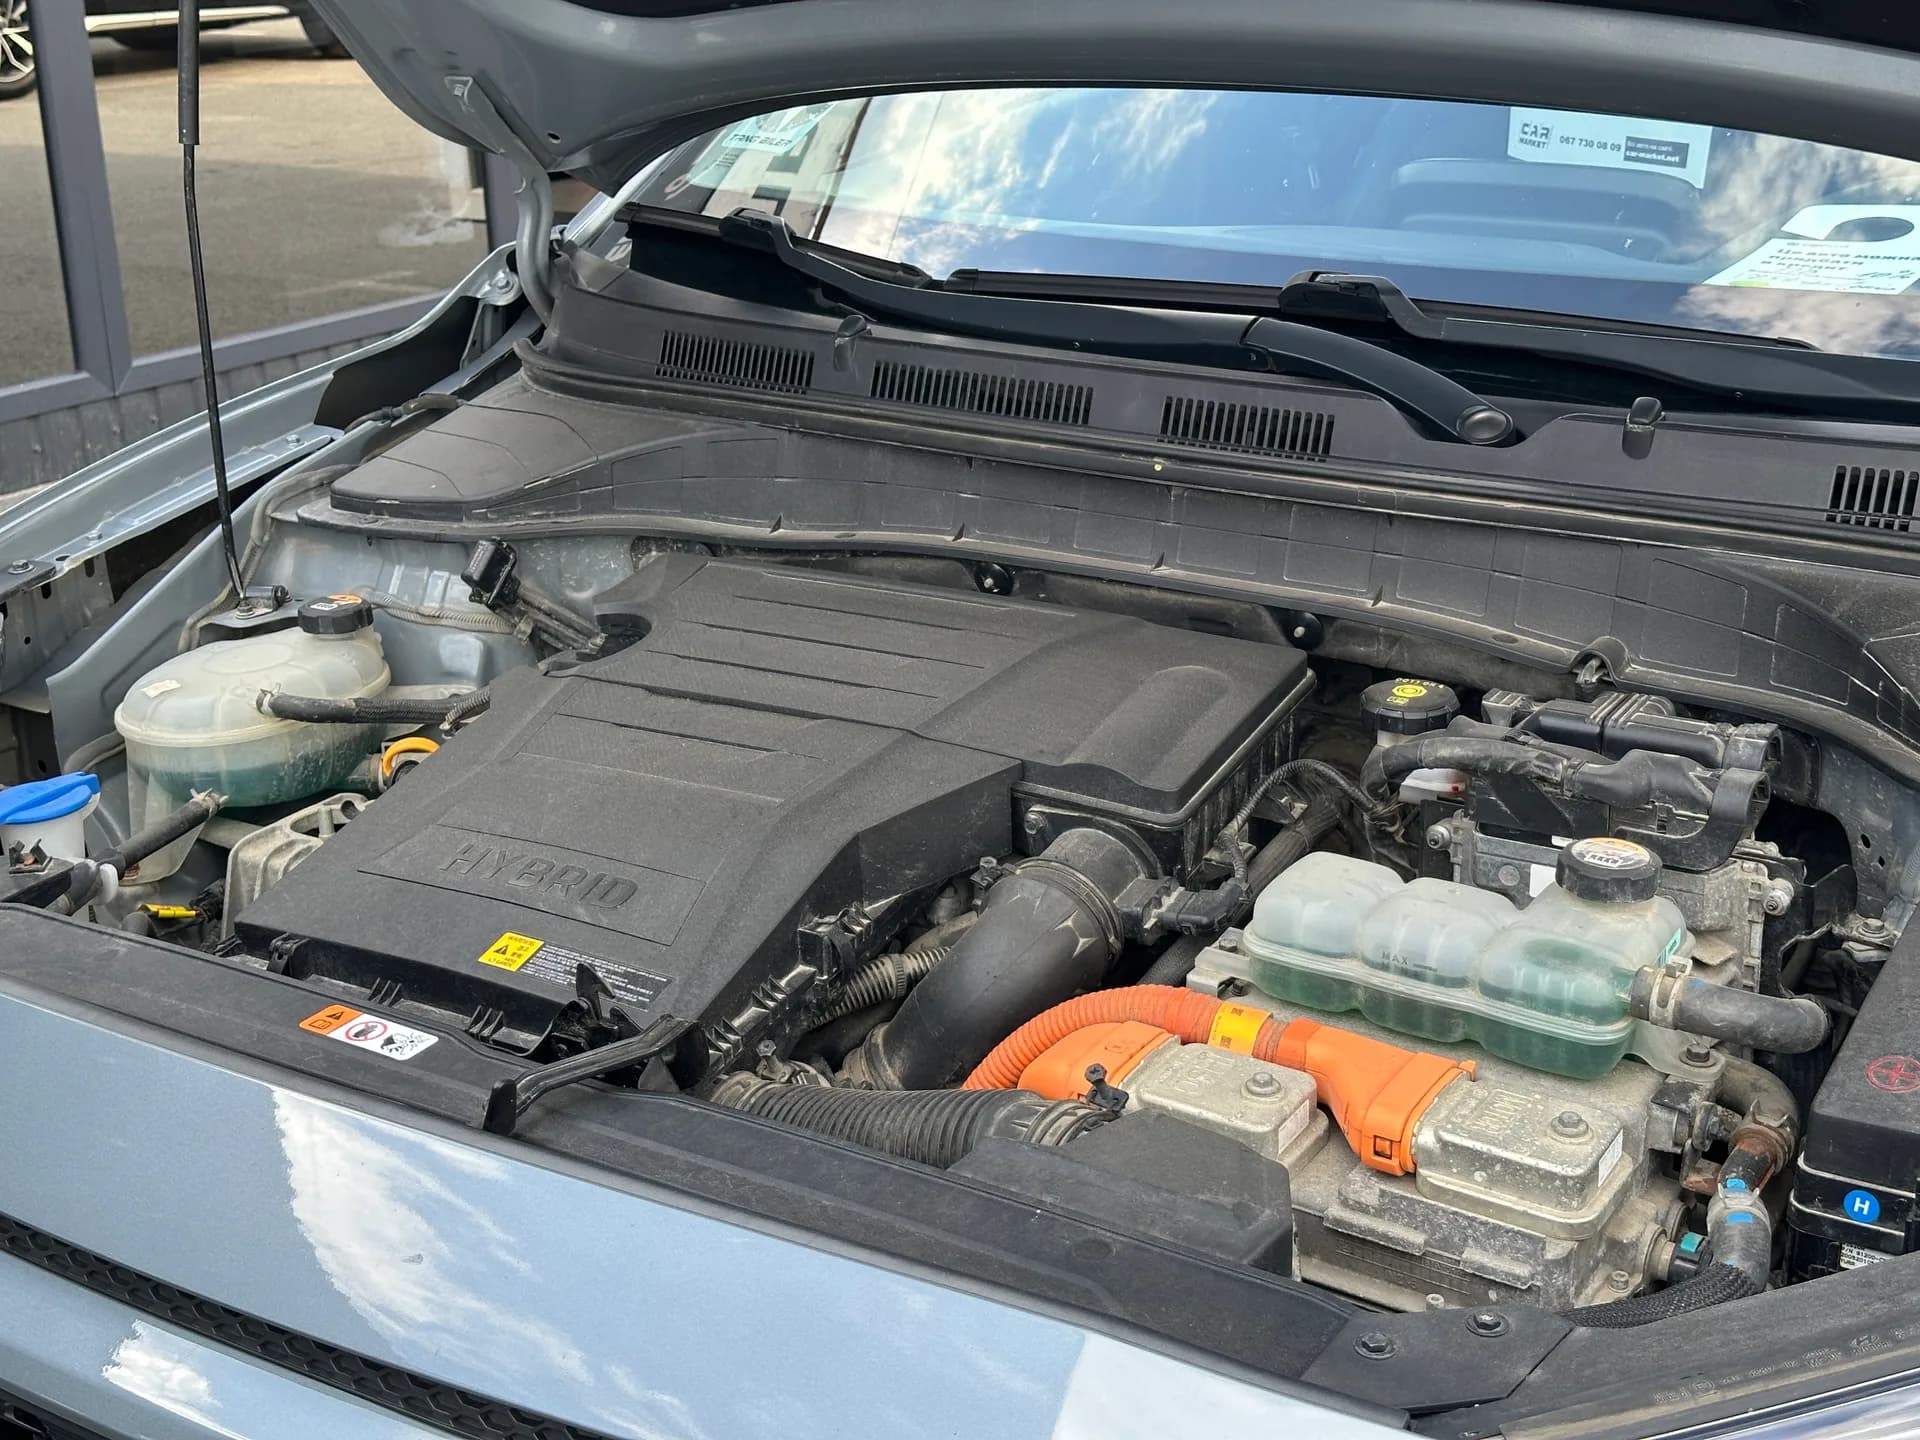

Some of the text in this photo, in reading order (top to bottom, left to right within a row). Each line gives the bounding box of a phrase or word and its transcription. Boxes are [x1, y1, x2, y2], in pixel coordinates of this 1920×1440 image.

[1521, 123, 1550, 140] CAR
[1578, 138, 1594, 148] 730
[1610, 143, 1622, 152] 09
[440, 843, 639, 909] HYBRID
[1382, 951, 1408, 965] MAX
[1853, 1196, 1871, 1216] H
